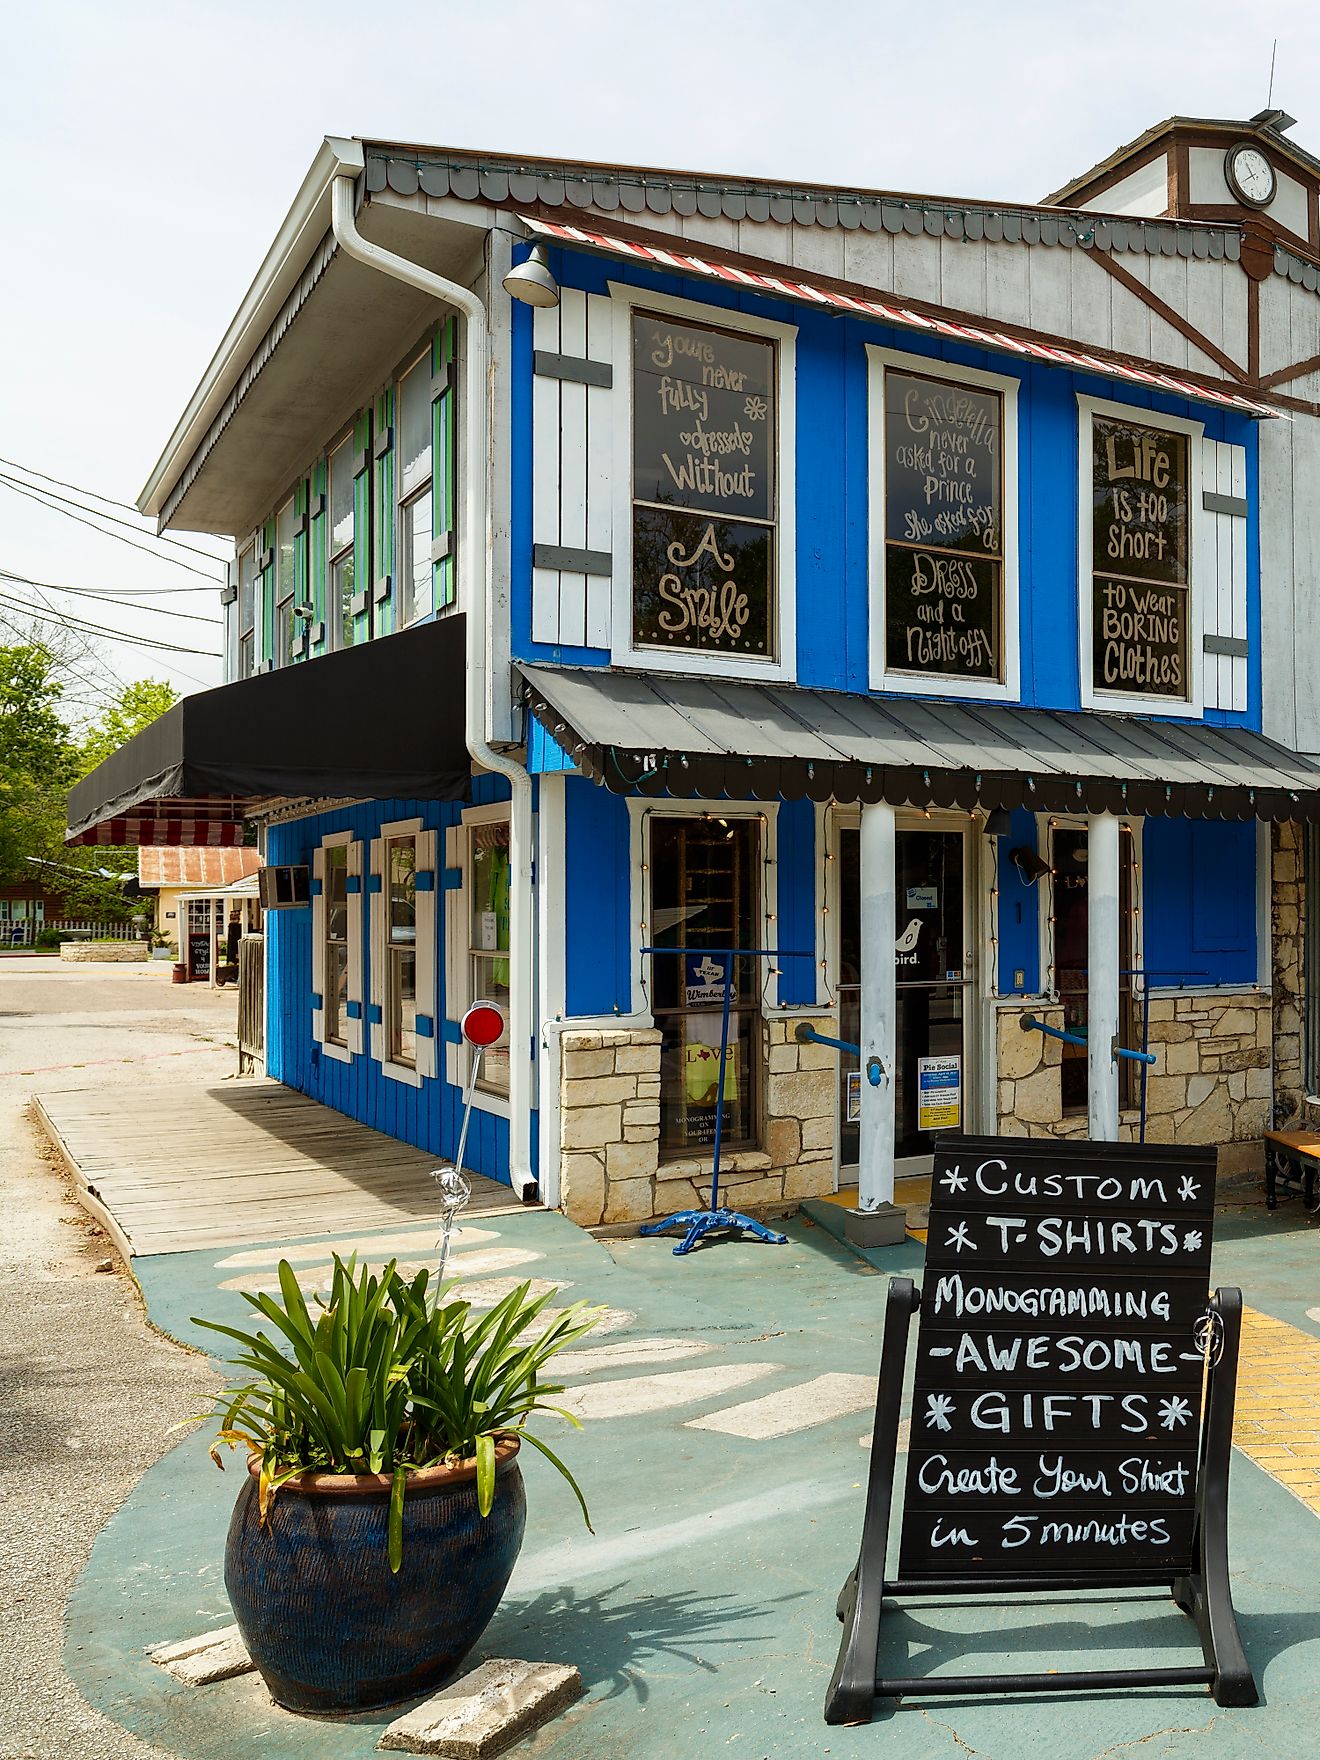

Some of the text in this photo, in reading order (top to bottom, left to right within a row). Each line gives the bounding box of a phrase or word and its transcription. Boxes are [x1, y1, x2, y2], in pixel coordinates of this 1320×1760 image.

[702, 365, 748, 392] never
[658, 376, 708, 421] fully
[904, 389, 997, 455] Cinderella
[928, 429, 971, 455] never
[896, 443, 978, 479] asked for a
[934, 507, 967, 538] asked
[968, 504, 995, 537] for
[983, 527, 999, 550] a
[667, 523, 735, 572] A
[658, 573, 750, 638] Smile
[917, 600, 965, 624] and a
[1103, 581, 1126, 609] to
[1103, 607, 1180, 644] BORING
[686, 989, 737, 1001] Wimberly
[970, 1392, 1149, 1433] GIFTS
[918, 1454, 1022, 1494] Create
[1032, 1454, 1112, 1498] Your
[930, 1513, 1171, 1548] in 5 minutes
